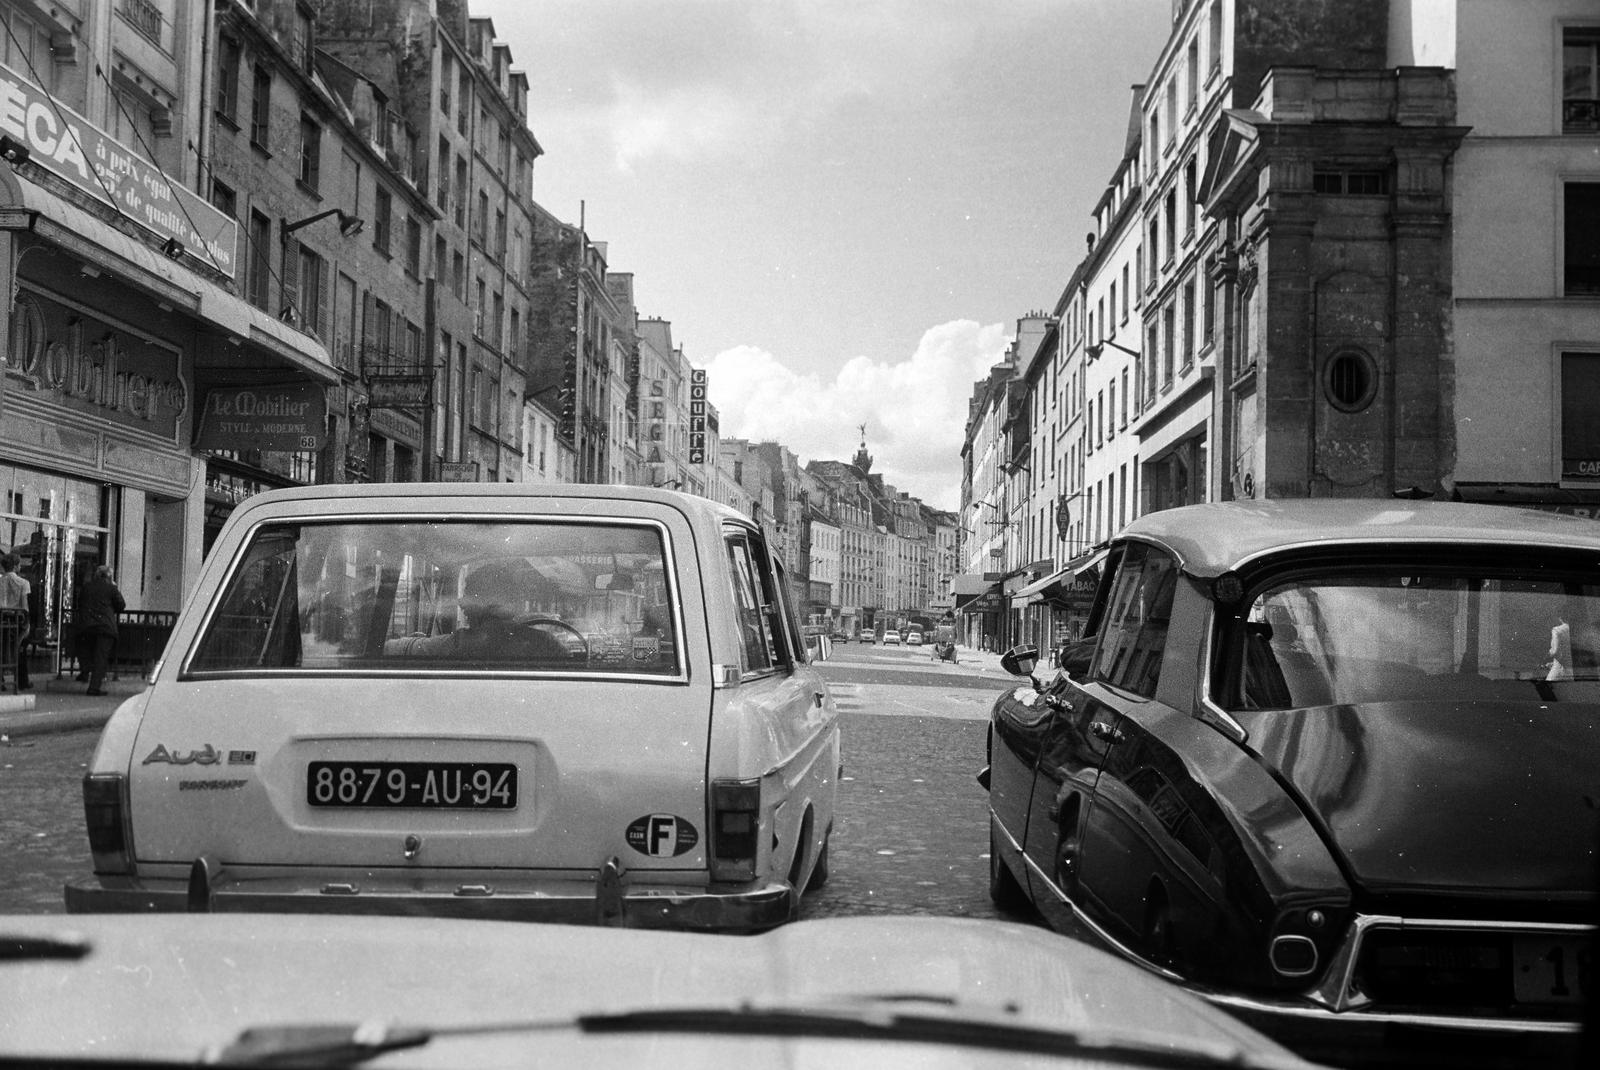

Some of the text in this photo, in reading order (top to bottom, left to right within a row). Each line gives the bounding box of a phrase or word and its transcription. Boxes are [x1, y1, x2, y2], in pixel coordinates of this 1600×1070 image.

[110, 151, 140, 182] prix
[143, 170, 171, 202] égal
[125, 187, 142, 209] de
[145, 204, 187, 236] qualité
[207, 240, 230, 265] plus
[211, 391, 310, 416] Le Mobilier
[219, 422, 252, 433] STYLE
[262, 423, 307, 434] MODERNE
[301, 437, 315, 447] 68
[1065, 580, 1096, 592] TABAC
[142, 743, 221, 766] Audi
[650, 817, 674, 855] F
